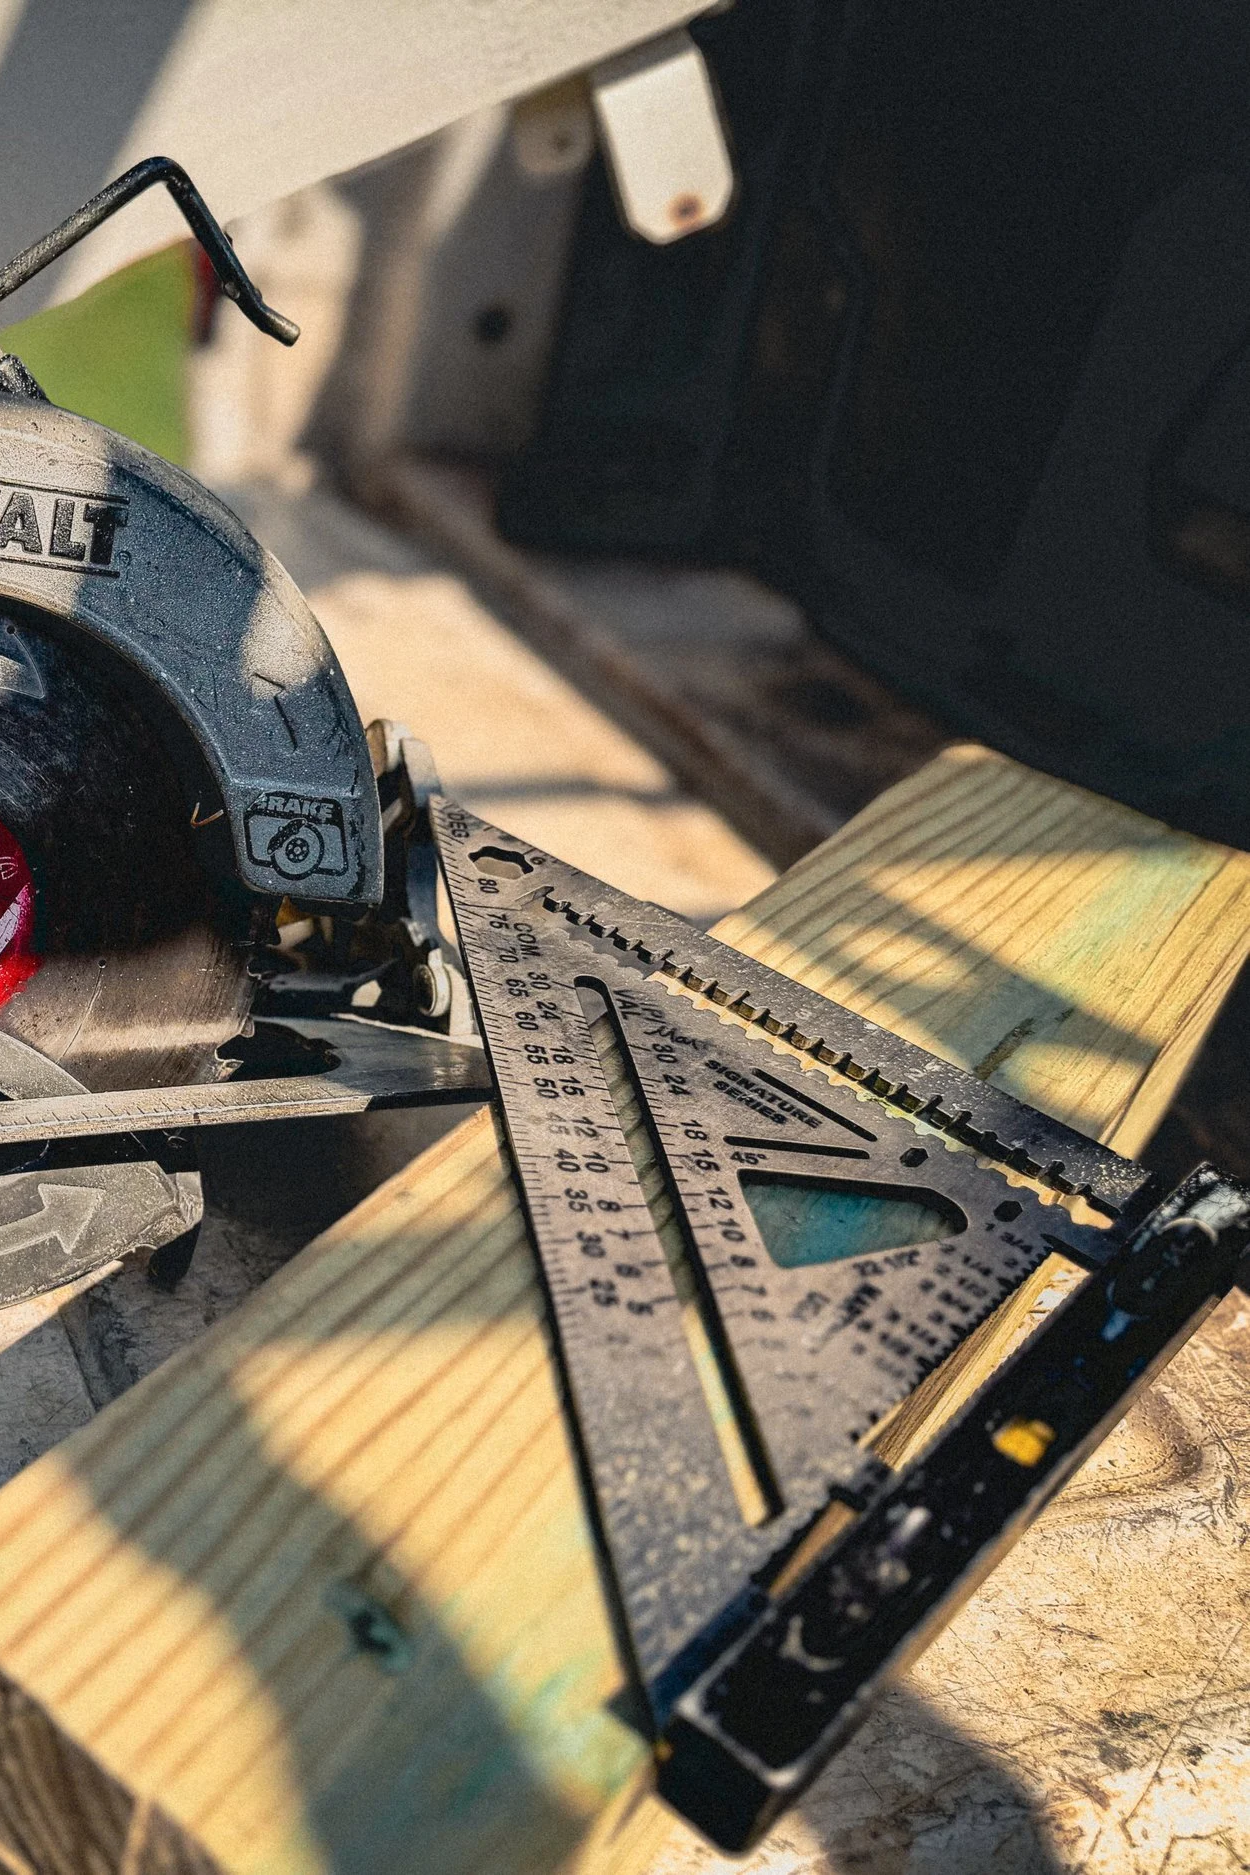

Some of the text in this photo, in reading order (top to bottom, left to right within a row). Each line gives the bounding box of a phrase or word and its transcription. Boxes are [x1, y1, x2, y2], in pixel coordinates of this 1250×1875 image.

[446, 812, 470, 839] DEG
[477, 878, 500, 895] 80
[487, 913, 511, 931] 75
[499, 946, 520, 964] 70
[505, 978, 530, 998] 65
[527, 971, 551, 991] 30
[535, 1001, 562, 1022] 24
[613, 988, 641, 1021] VAL
[514, 1011, 540, 1032] 60
[524, 1043, 550, 1065] 55
[550, 1045, 576, 1065] 18
[652, 1043, 679, 1065] 30
[533, 1077, 560, 1100] 50
[558, 1075, 586, 1098] 15
[662, 1073, 691, 1097] 24
[704, 1058, 824, 1130] SIGNATURE
[712, 1080, 789, 1126] SERIES
[571, 1115, 599, 1138] 12
[680, 1119, 708, 1142] 18
[553, 1148, 582, 1174] 40
[582, 1151, 611, 1174] 10
[690, 1149, 721, 1172] 15
[729, 1150, 768, 1166] 45°
[564, 1187, 594, 1214] 35
[705, 1186, 735, 1212] 12
[717, 1217, 747, 1243] 10
[576, 1231, 607, 1258] 30
